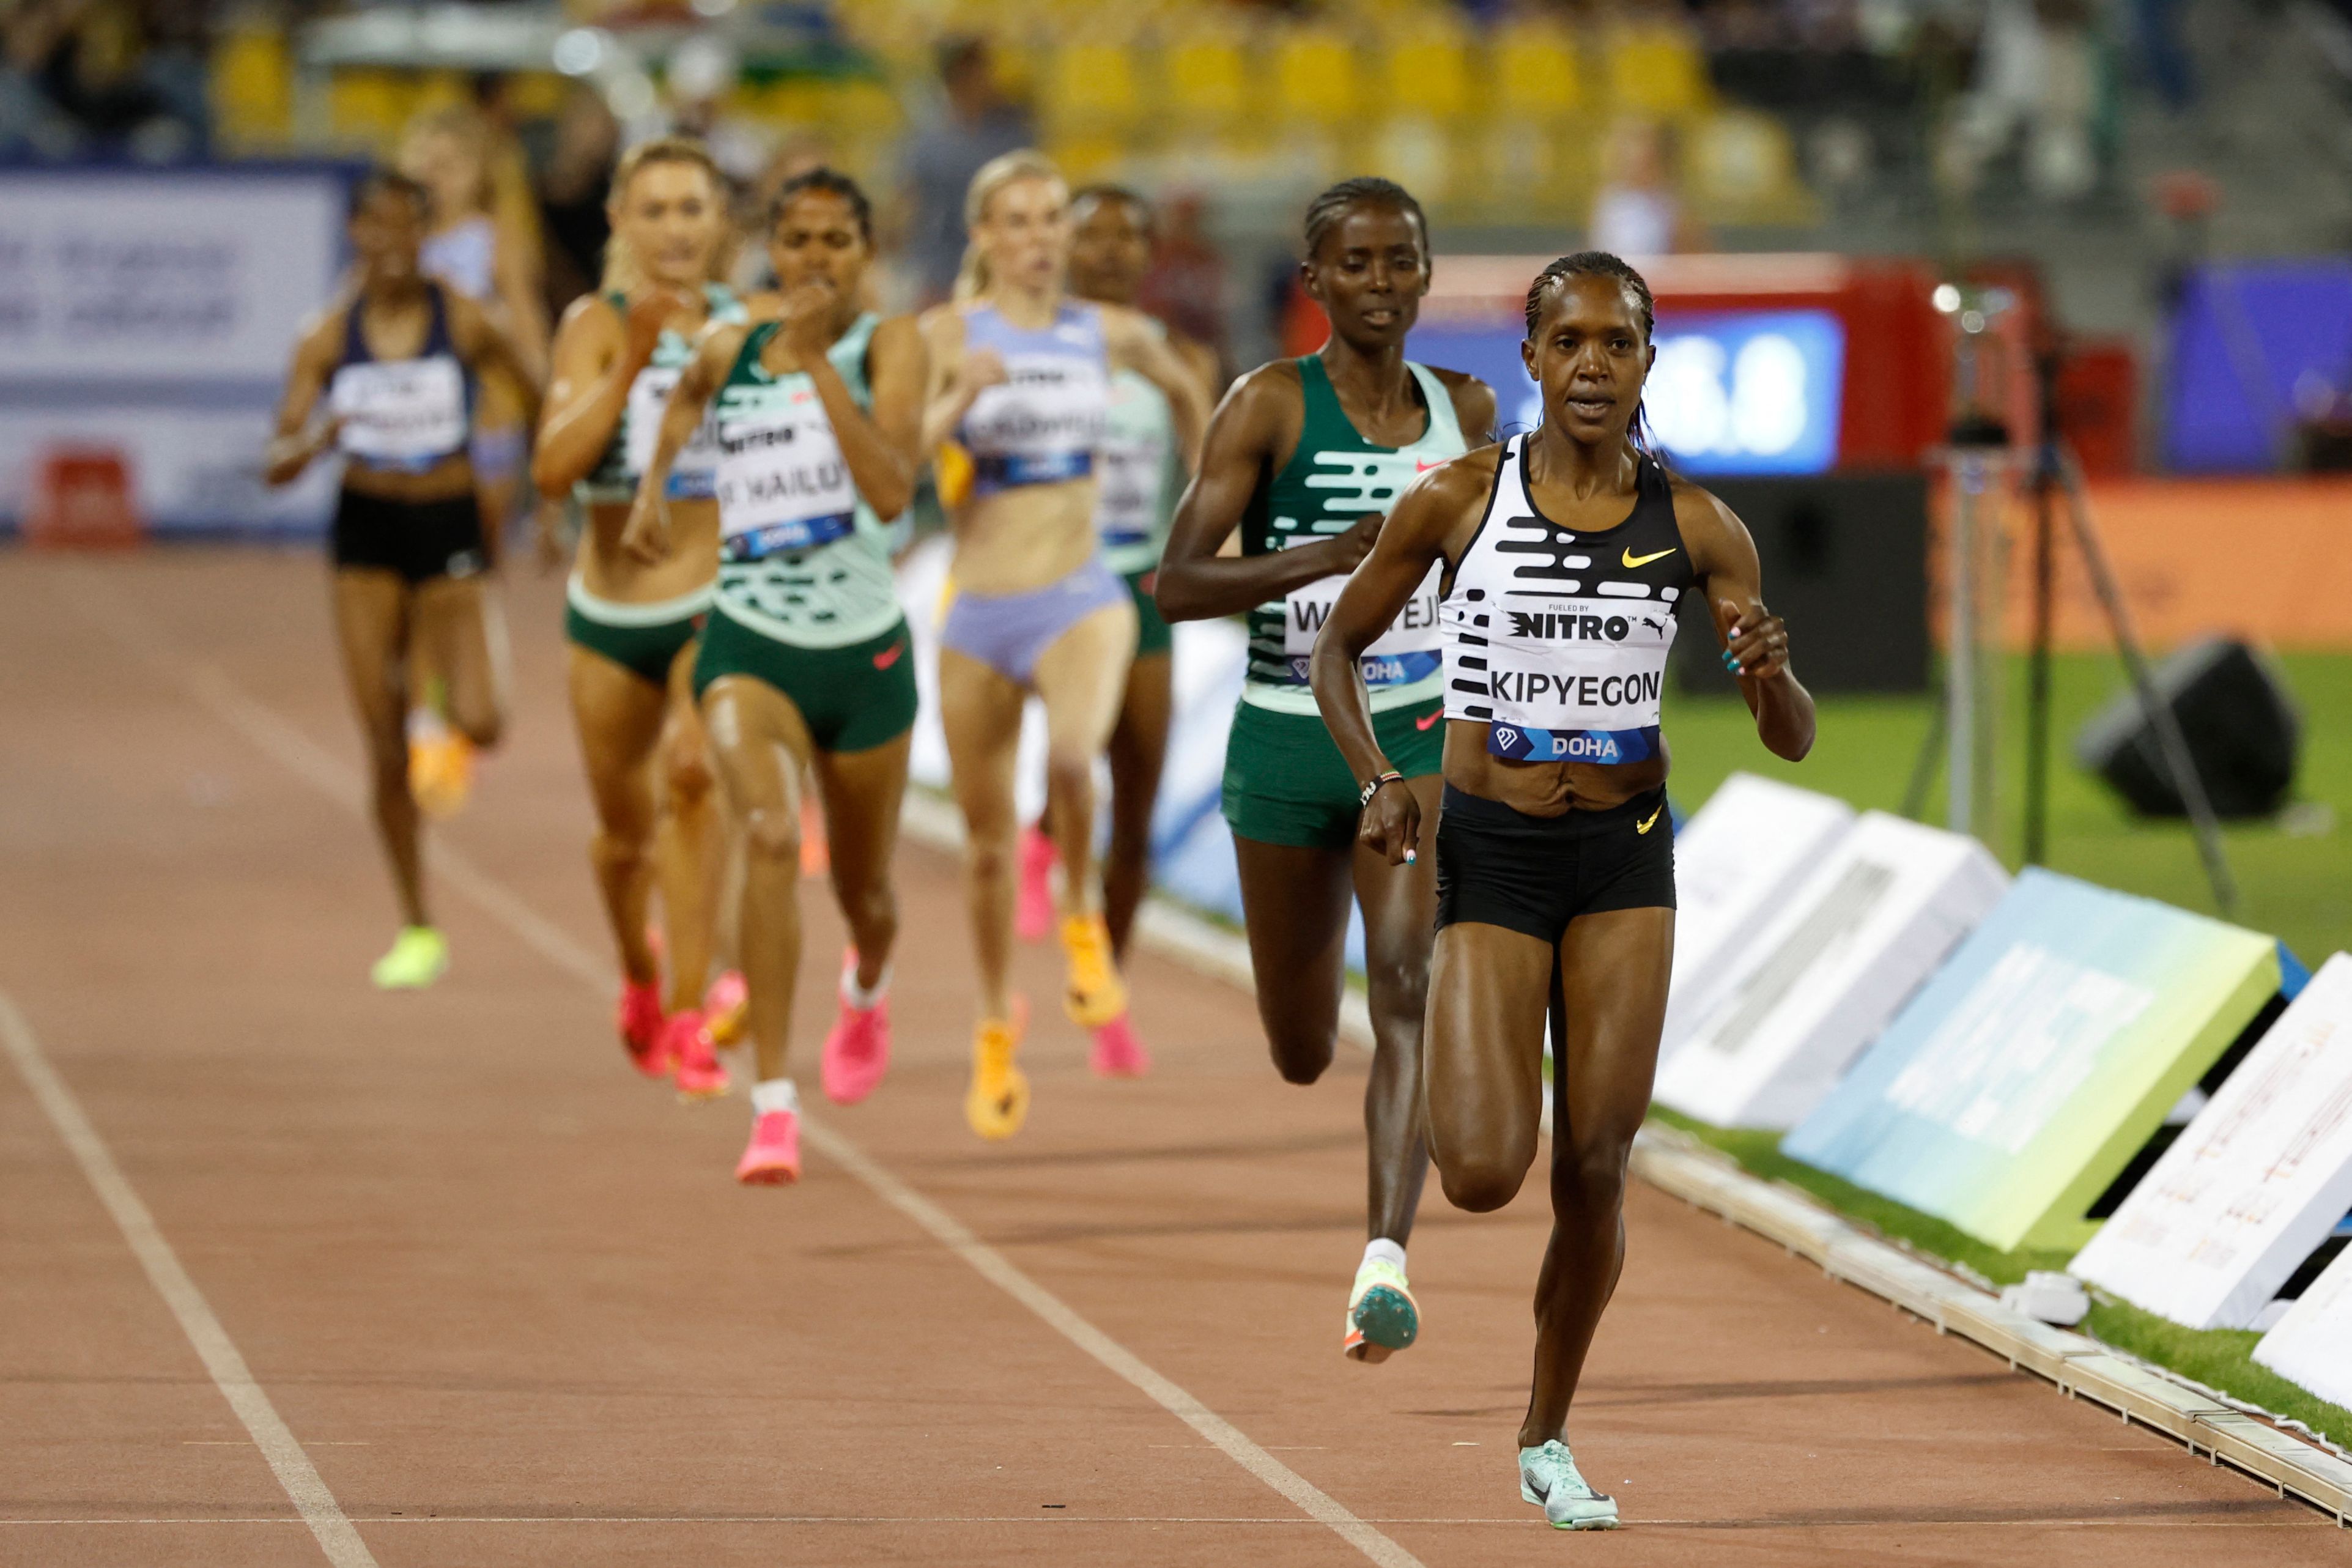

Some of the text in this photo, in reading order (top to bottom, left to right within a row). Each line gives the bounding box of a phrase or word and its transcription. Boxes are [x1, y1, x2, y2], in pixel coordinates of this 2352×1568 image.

[1507, 612, 1629, 641] NITRO
[1362, 660, 1405, 680] OHA
[1491, 671, 1660, 706] KIPYEGON
[1551, 738, 1618, 757] DOHA
